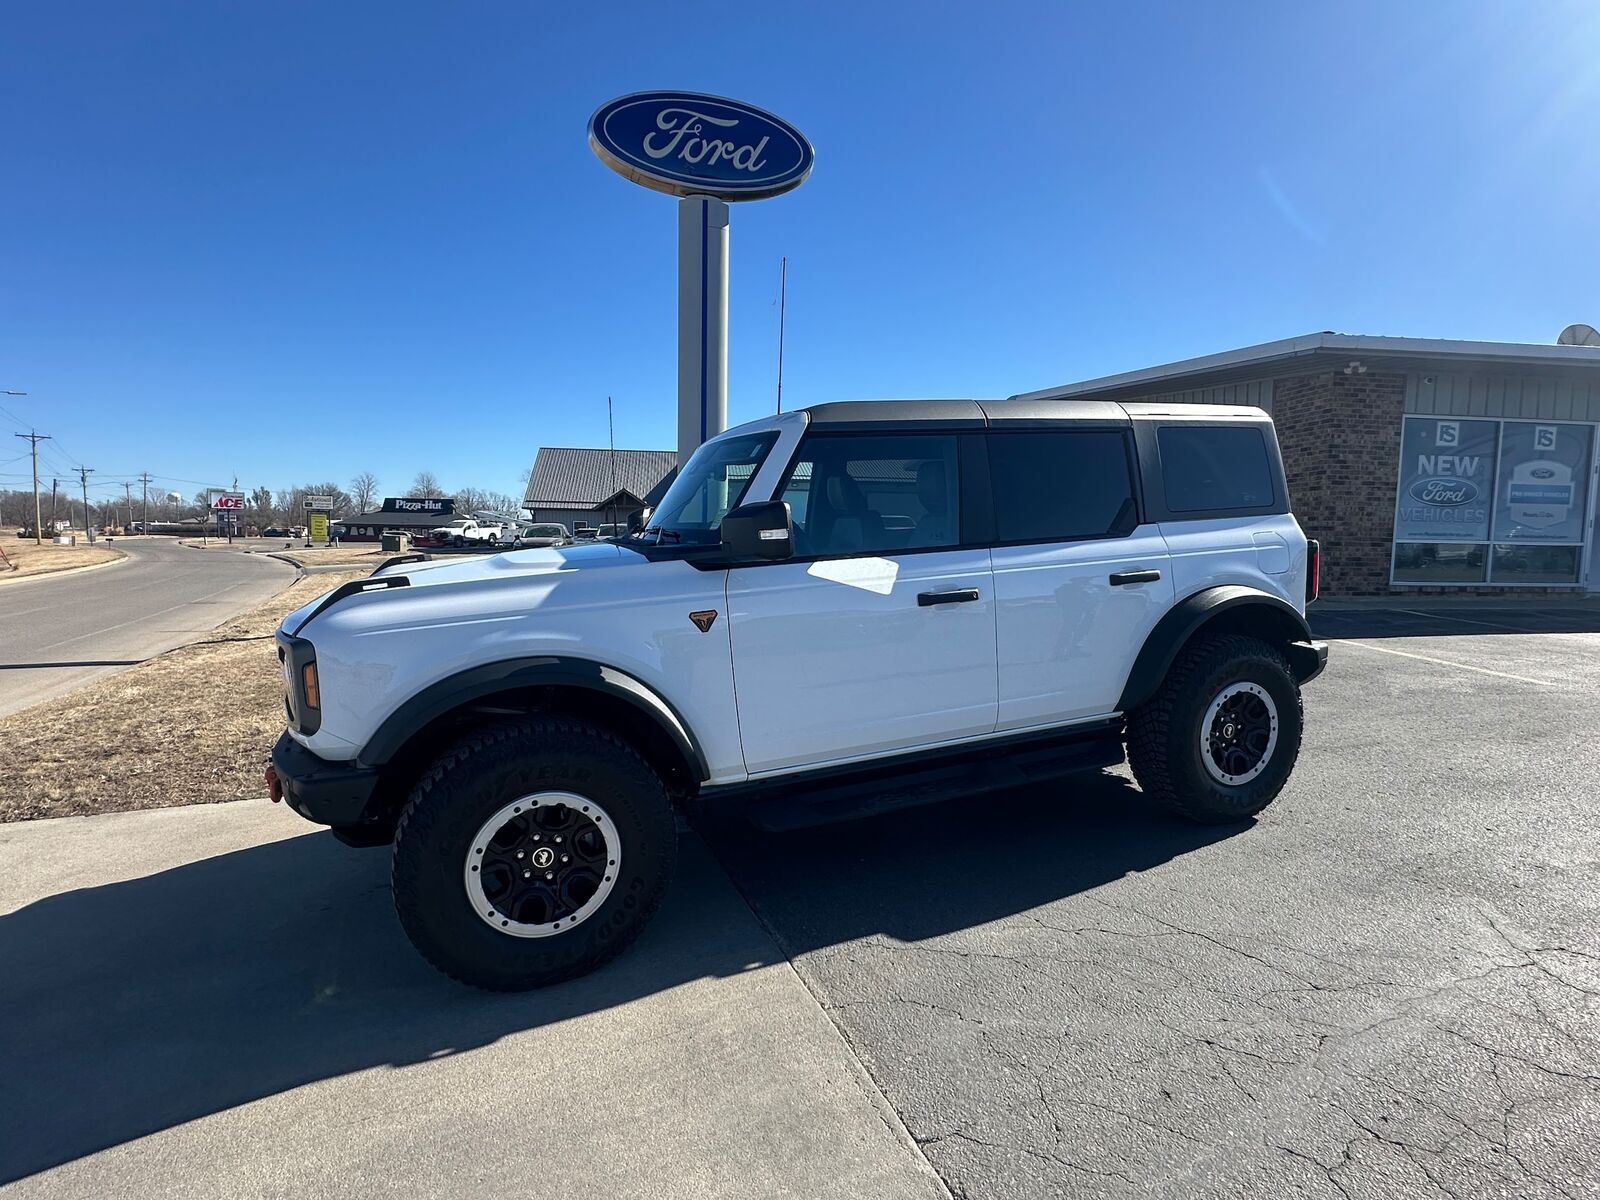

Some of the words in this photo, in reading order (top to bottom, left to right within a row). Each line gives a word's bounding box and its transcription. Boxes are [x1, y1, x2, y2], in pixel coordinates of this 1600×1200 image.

[643, 108, 770, 172] Ford
[1417, 454, 1480, 477] NEW
[1422, 480, 1465, 502] Ford
[213, 496, 243, 508] ACE
[395, 499, 421, 511] Pizza
[424, 500, 443, 510] Hut
[1400, 507, 1485, 523] VEHICLES
